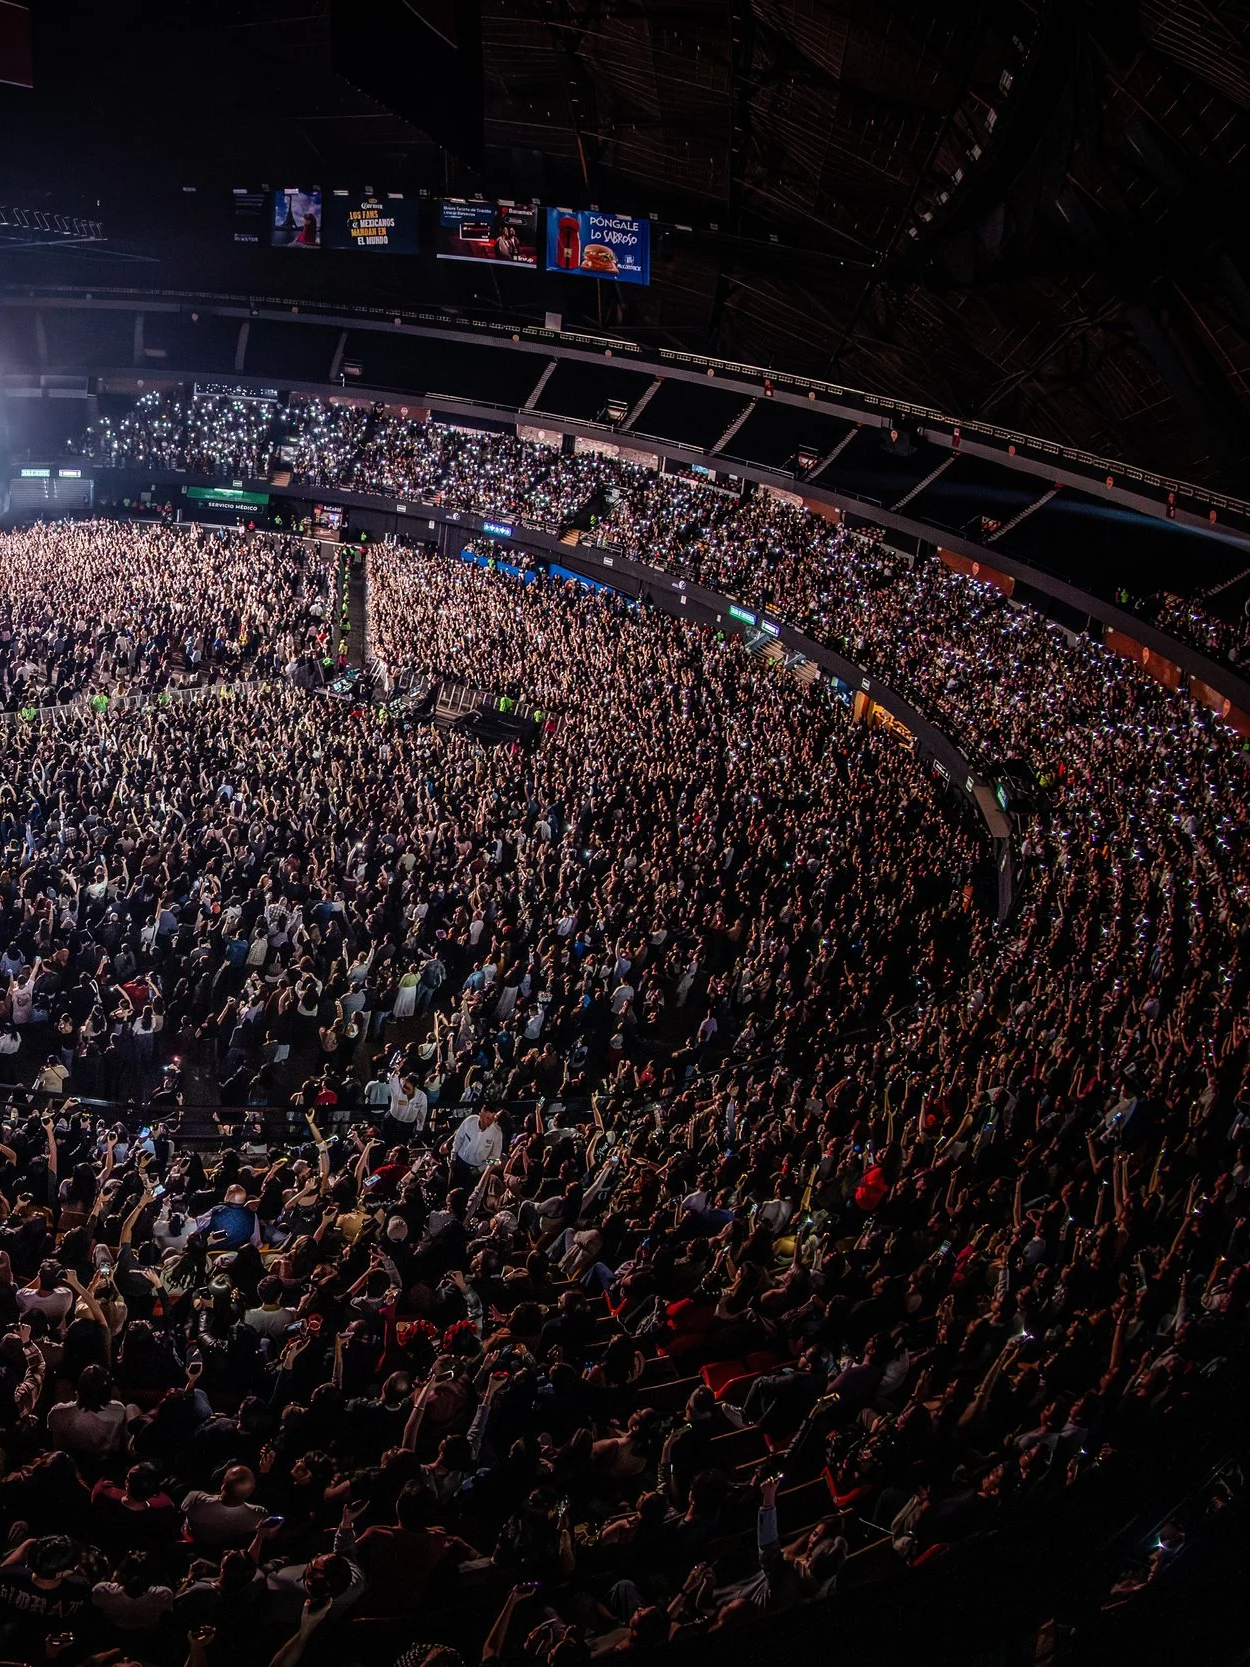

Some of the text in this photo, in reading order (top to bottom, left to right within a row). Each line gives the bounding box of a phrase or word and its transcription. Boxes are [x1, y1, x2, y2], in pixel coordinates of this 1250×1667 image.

[350, 210, 379, 220] LOS FANS
[508, 208, 533, 216] Banamex
[360, 218, 395, 228] MEXICANOS
[589, 216, 639, 232] PÓNGALE
[351, 227, 387, 237] MANDAN EN
[357, 236, 389, 245] EL MUNDO
[603, 229, 638, 246] SABROSO
[235, 503, 258, 511] MÉDICO
